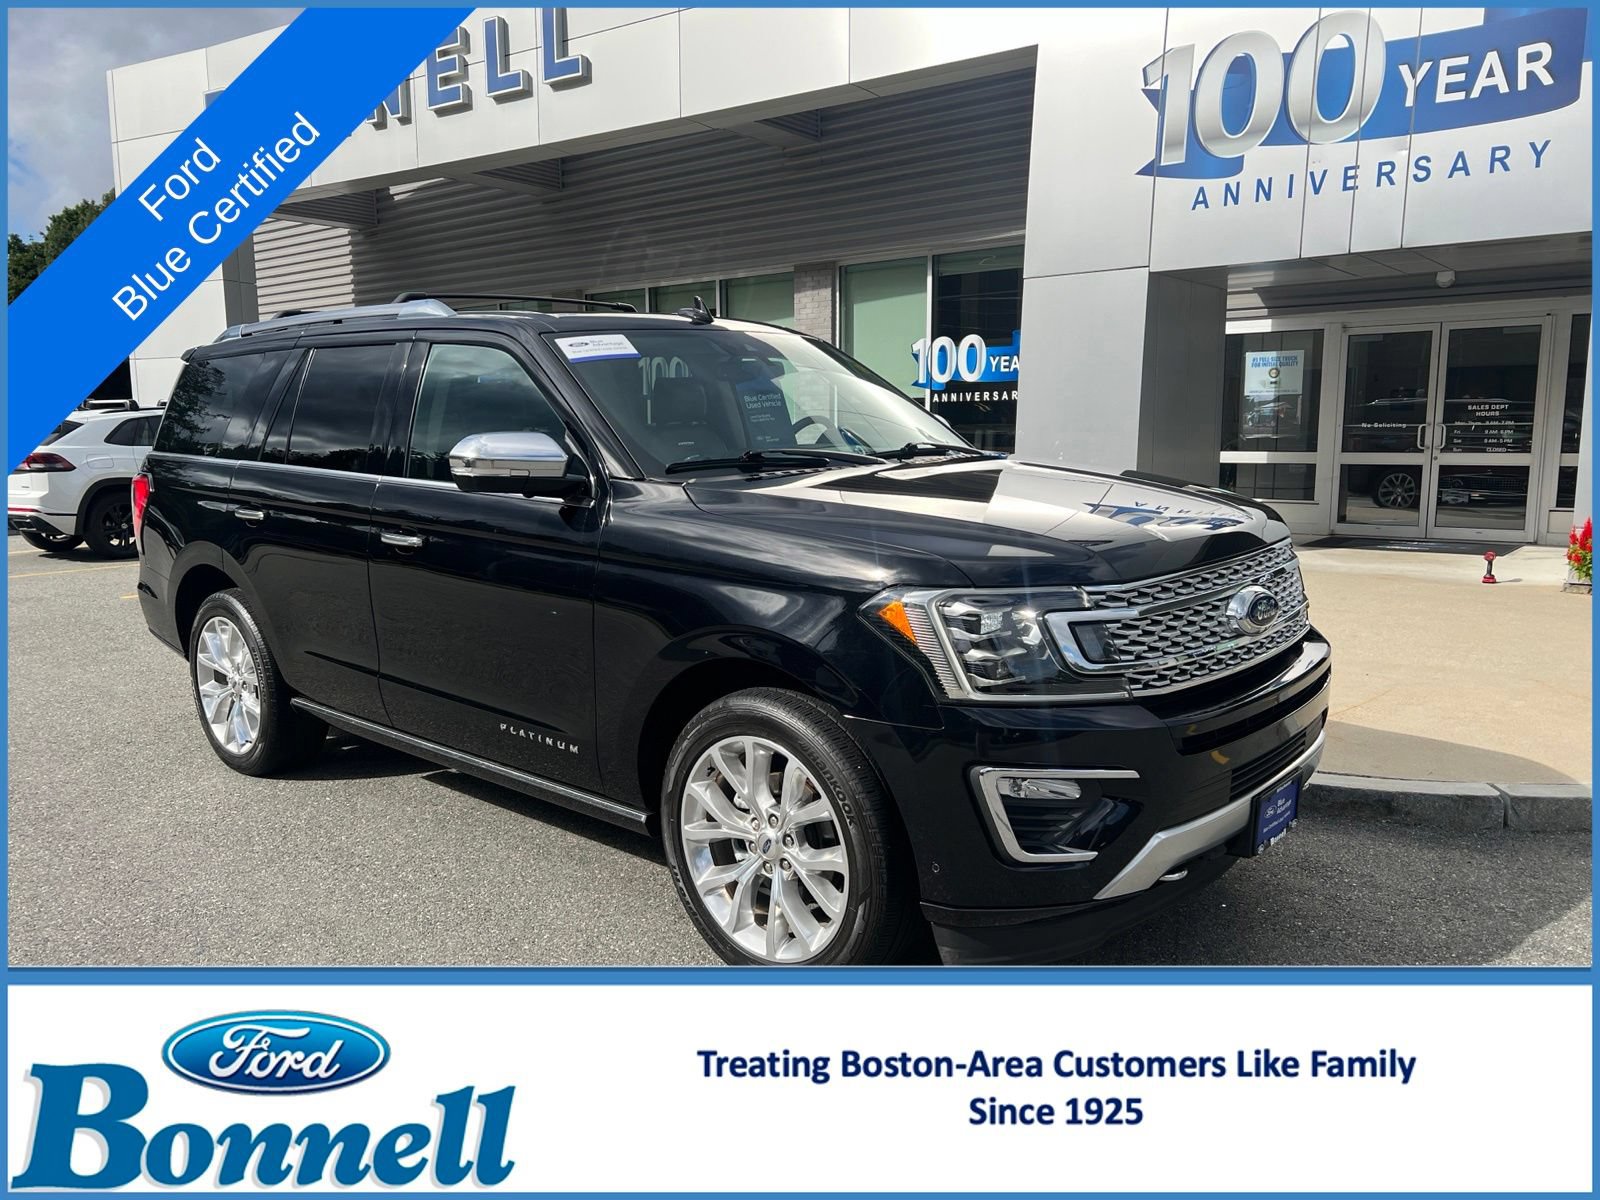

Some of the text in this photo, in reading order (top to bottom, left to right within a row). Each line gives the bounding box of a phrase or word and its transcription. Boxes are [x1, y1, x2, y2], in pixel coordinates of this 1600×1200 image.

[1141, 10, 1554, 166] 100 YEAR
[1191, 139, 1551, 210] ANNIVERSARY
[911, 334, 987, 384] 100
[500, 723, 579, 754] PLATINUM
